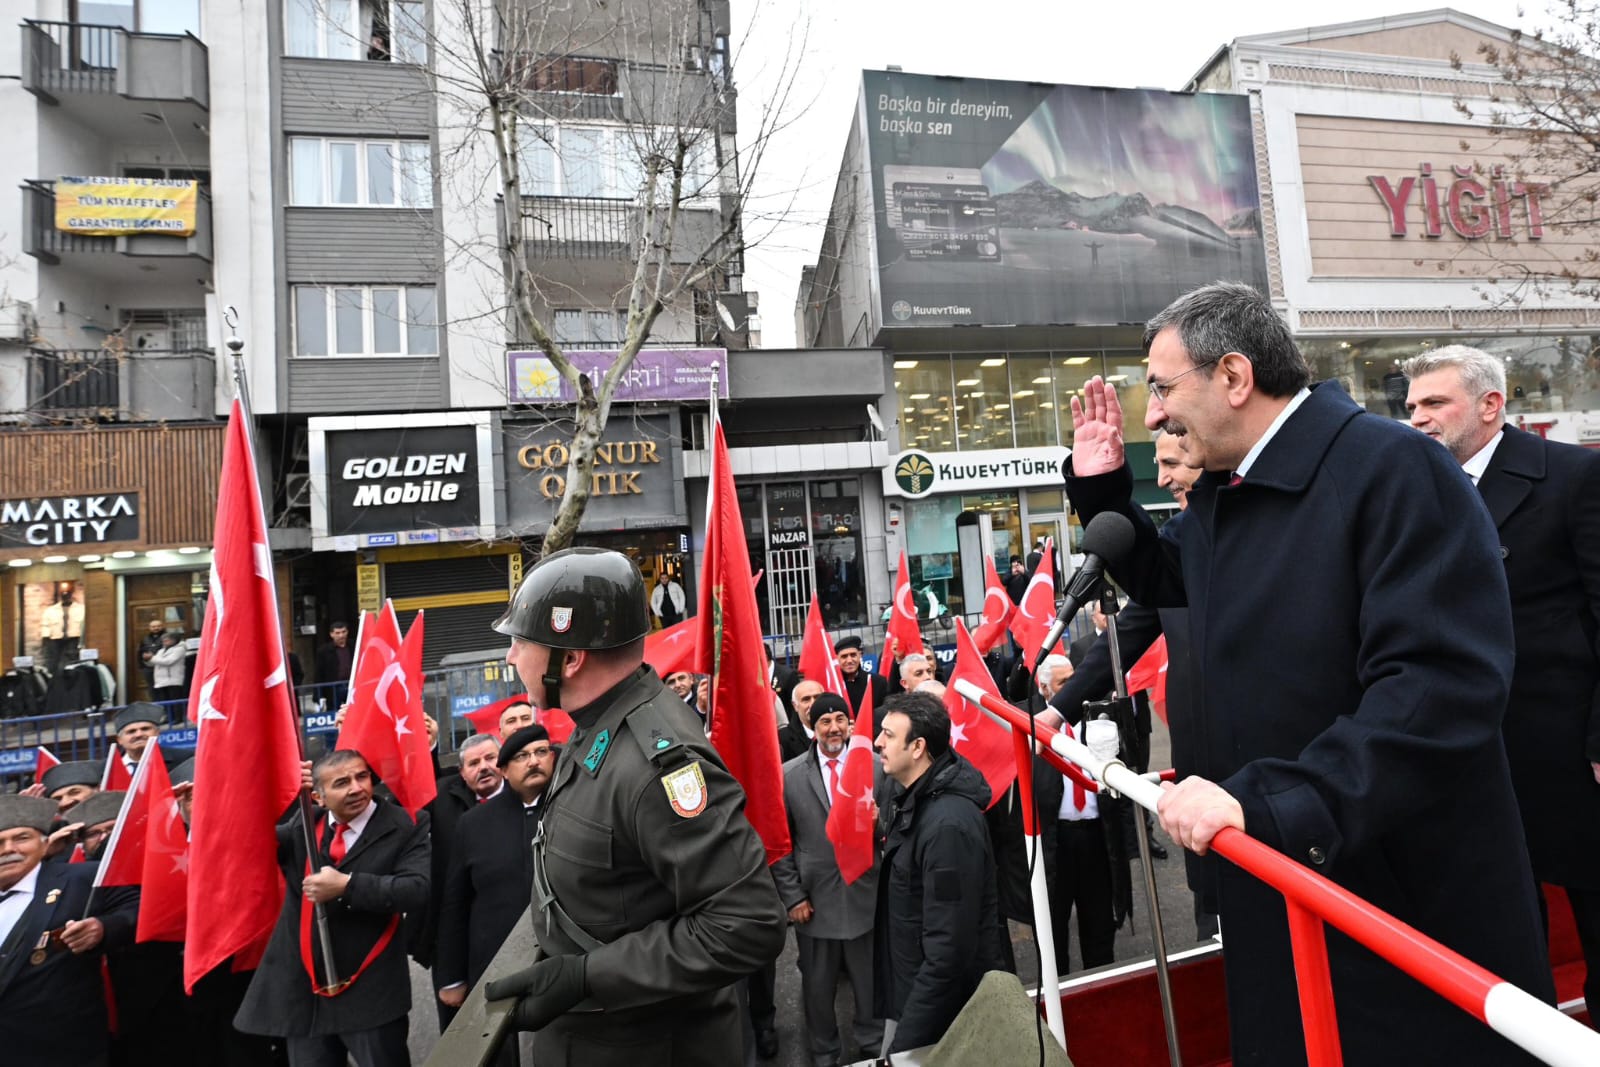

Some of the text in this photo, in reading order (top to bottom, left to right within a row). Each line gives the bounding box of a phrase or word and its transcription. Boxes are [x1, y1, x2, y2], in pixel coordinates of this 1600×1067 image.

[878, 94, 1013, 121] Başka bir deneyim,
[880, 115, 952, 137] başka sen
[1367, 162, 1548, 240] YİĞİT
[342, 453, 467, 480] GOLDEN
[517, 439, 661, 469] GÖNUR
[352, 480, 459, 507] Mobile
[539, 469, 643, 500] OTİK
[1, 495, 134, 524] MARKA
[25, 519, 112, 545] CITY
[771, 531, 807, 544] NAZAR
[306, 715, 336, 728] POL
